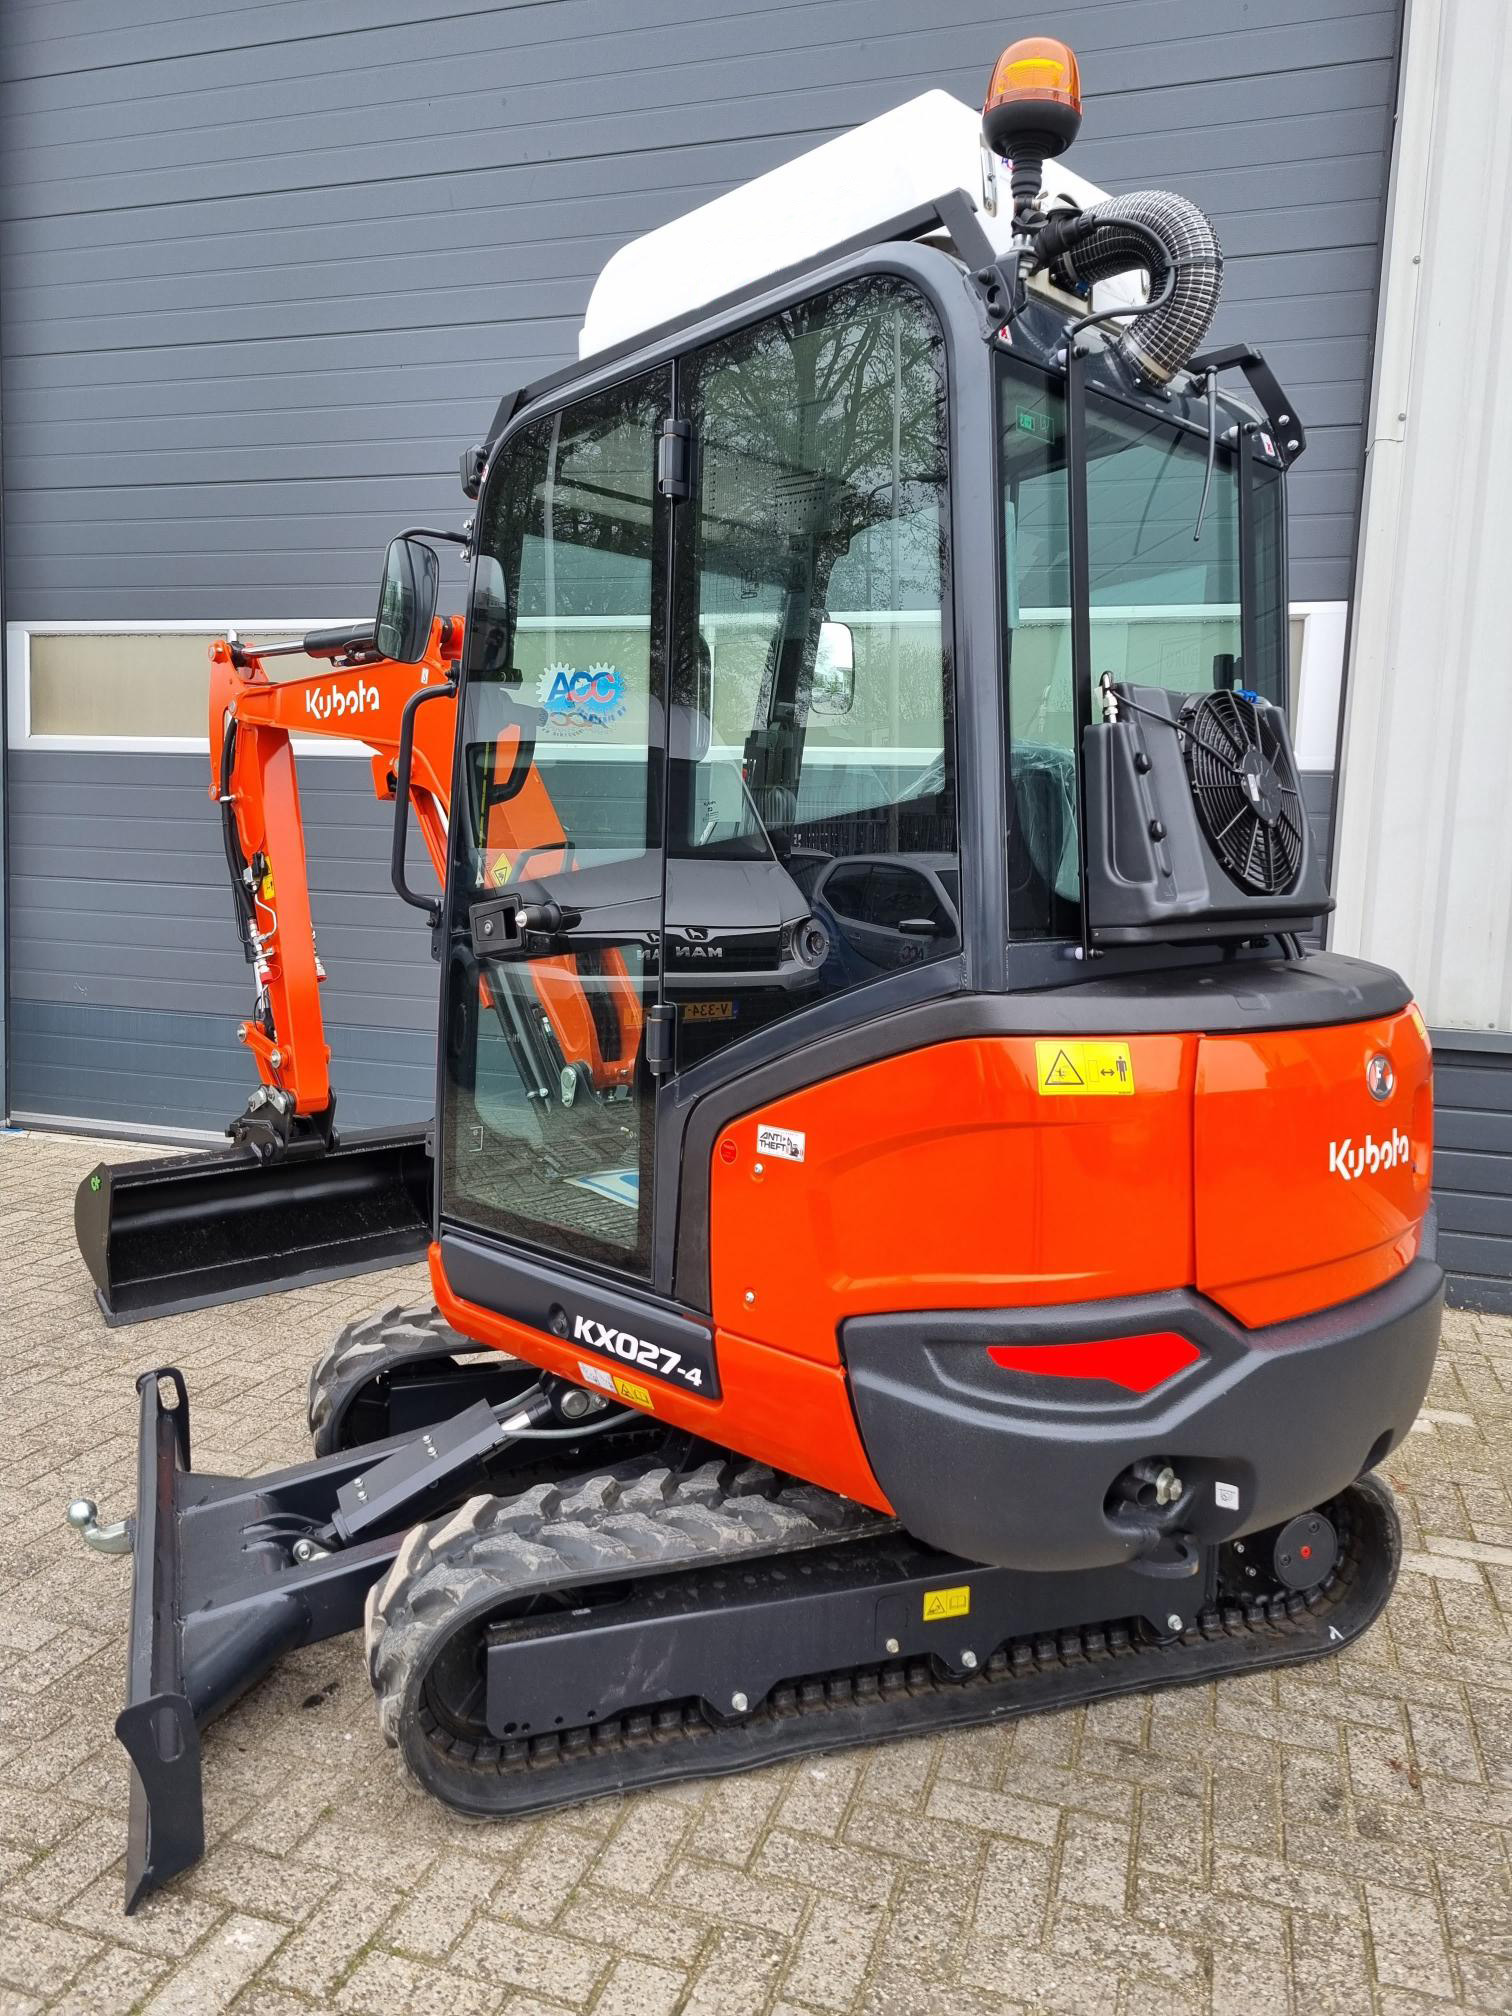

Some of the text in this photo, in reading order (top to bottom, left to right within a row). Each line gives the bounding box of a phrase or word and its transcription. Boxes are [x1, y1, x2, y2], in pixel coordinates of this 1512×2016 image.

[305, 679, 380, 720] Kubota
[547, 671, 616, 703] ACC
[759, 1139, 787, 1152] THEFT
[760, 1131, 783, 1143] ANTI
[1328, 1127, 1409, 1181] Kubota
[573, 1315, 703, 1387] KX027-4
